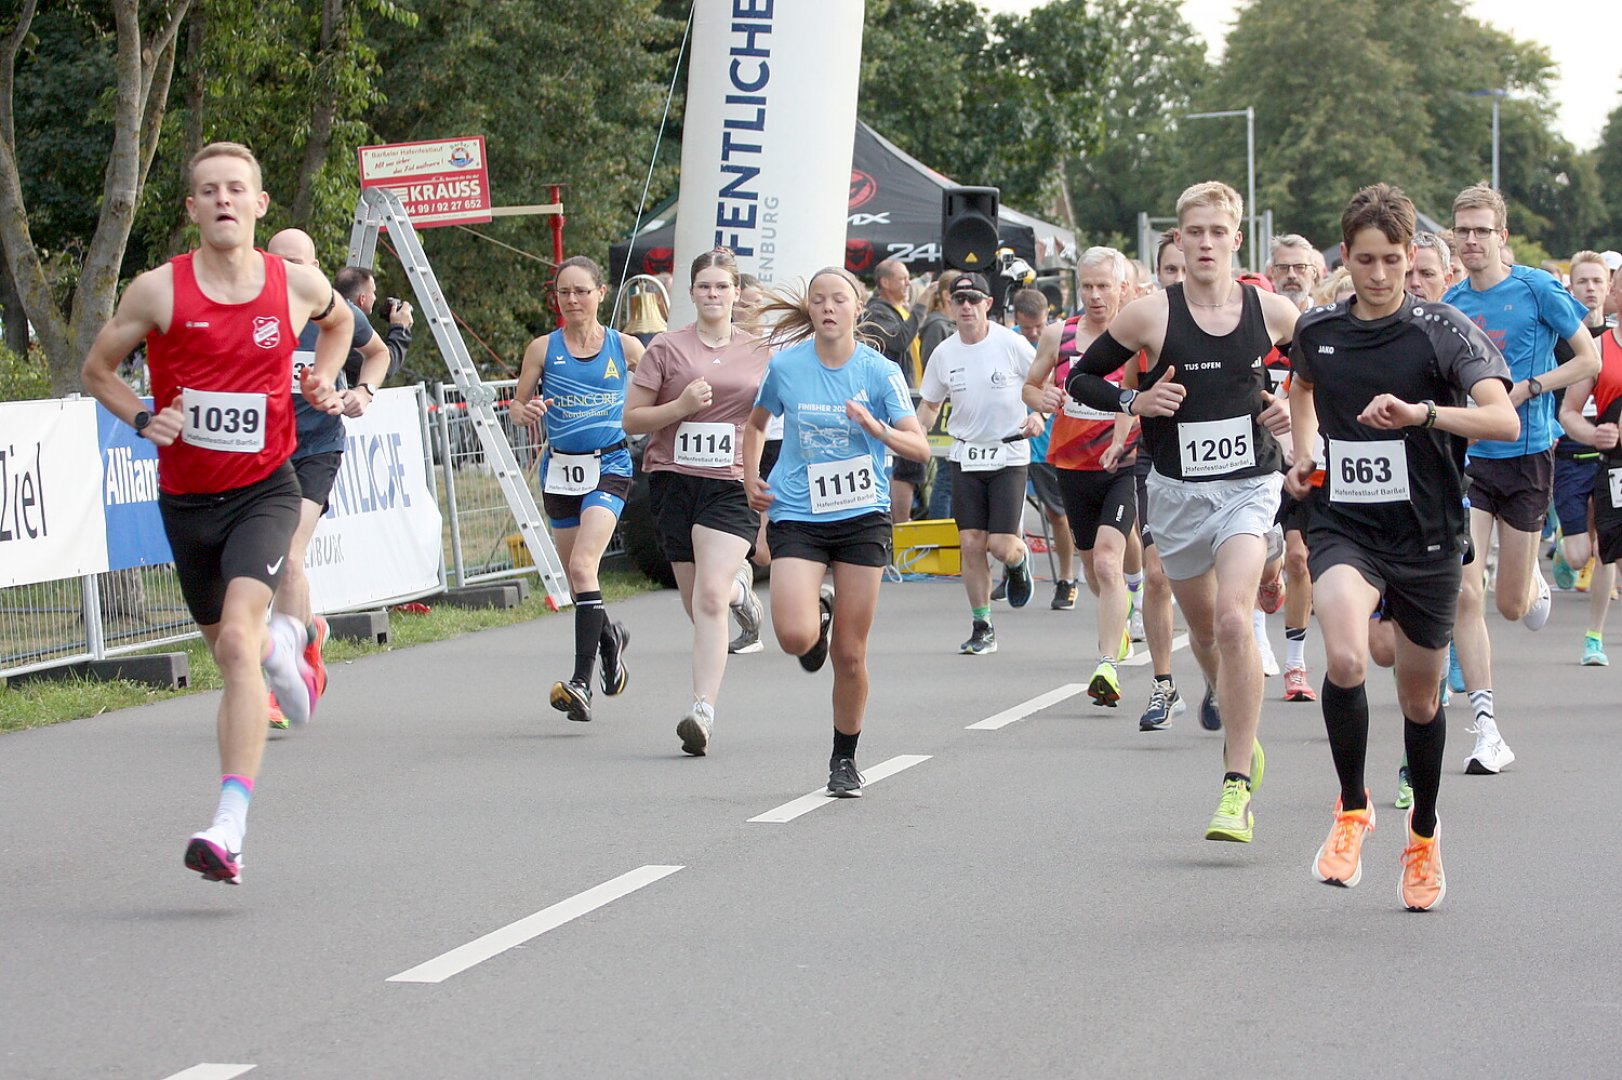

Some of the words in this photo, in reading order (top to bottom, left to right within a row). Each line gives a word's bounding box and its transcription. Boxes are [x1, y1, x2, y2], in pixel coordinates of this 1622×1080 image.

[410, 179, 481, 202] KRAUSS
[417, 203, 429, 213] 99
[437, 201, 449, 211] 92
[450, 200, 463, 211] 27
[464, 199, 482, 209] 652
[1318, 345, 1335, 355] JAKO
[1184, 362, 1199, 371] TUS
[1200, 361, 1222, 370] OFEN
[552, 392, 617, 406] GLENCORE
[562, 409, 609, 419] Nordenham
[797, 403, 832, 412] FINISHER
[832, 404, 847, 413] 202
[189, 404, 260, 433] 1039
[679, 432, 732, 454] 1114
[1186, 434, 1247, 462] 1205
[968, 447, 999, 461] 617
[562, 465, 585, 484] 10
[1186, 463, 1229, 472] Hafenfestlauf
[1341, 456, 1393, 484] 663
[106, 446, 161, 506] Allian
[325, 432, 412, 520] NTLICHE
[814, 468, 872, 497] 1113
[1334, 487, 1379, 497] Hafenfestlauf
[1380, 486, 1406, 496] Barßel
